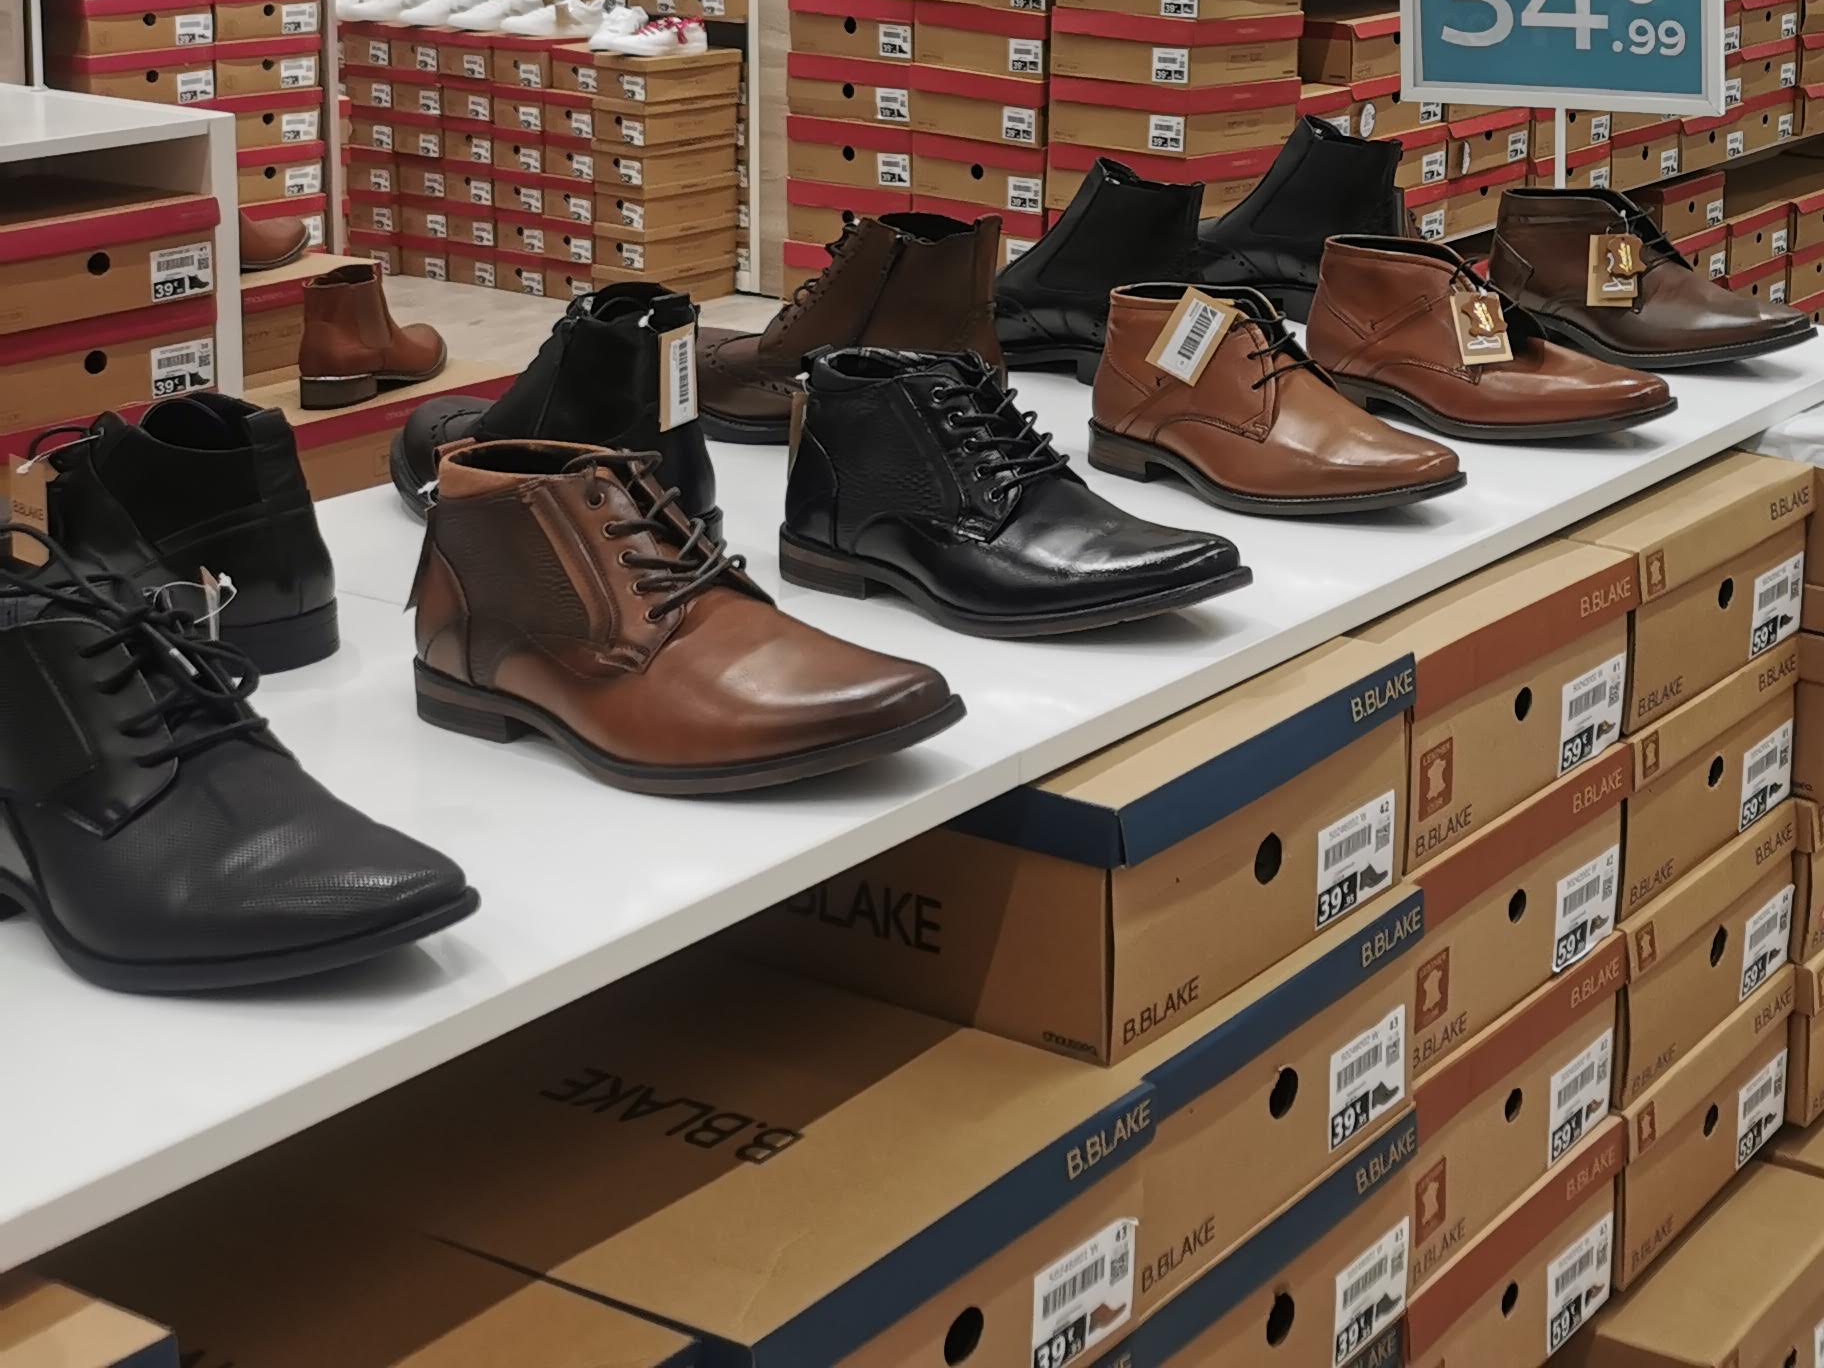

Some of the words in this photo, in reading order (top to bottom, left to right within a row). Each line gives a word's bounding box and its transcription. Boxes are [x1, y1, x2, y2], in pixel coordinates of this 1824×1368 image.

[154, 282, 175, 298] 39
[154, 379, 175, 394] 39
[1753, 626, 1768, 653] 59
[1351, 668, 1414, 723] B.BLAKE
[1562, 740, 1582, 768] 59
[1380, 800, 1390, 815] 42
[1572, 767, 1624, 814] B.BLAKE
[1415, 804, 1473, 858] B.BLAKE
[1318, 888, 1341, 924] 39
[1360, 905, 1422, 969] B.BLAKE
[1557, 939, 1576, 967] 59
[1571, 956, 1620, 1009] B.BLAKE
[1123, 975, 1200, 1047] B.BLAKE
[1066, 1098, 1151, 1180] B.BLAKE
[1333, 1108, 1356, 1146] 39
[1553, 1126, 1571, 1158] 59
[1356, 1127, 1416, 1195] B.BLAKE
[1142, 1217, 1215, 1294] B.BLAKE
